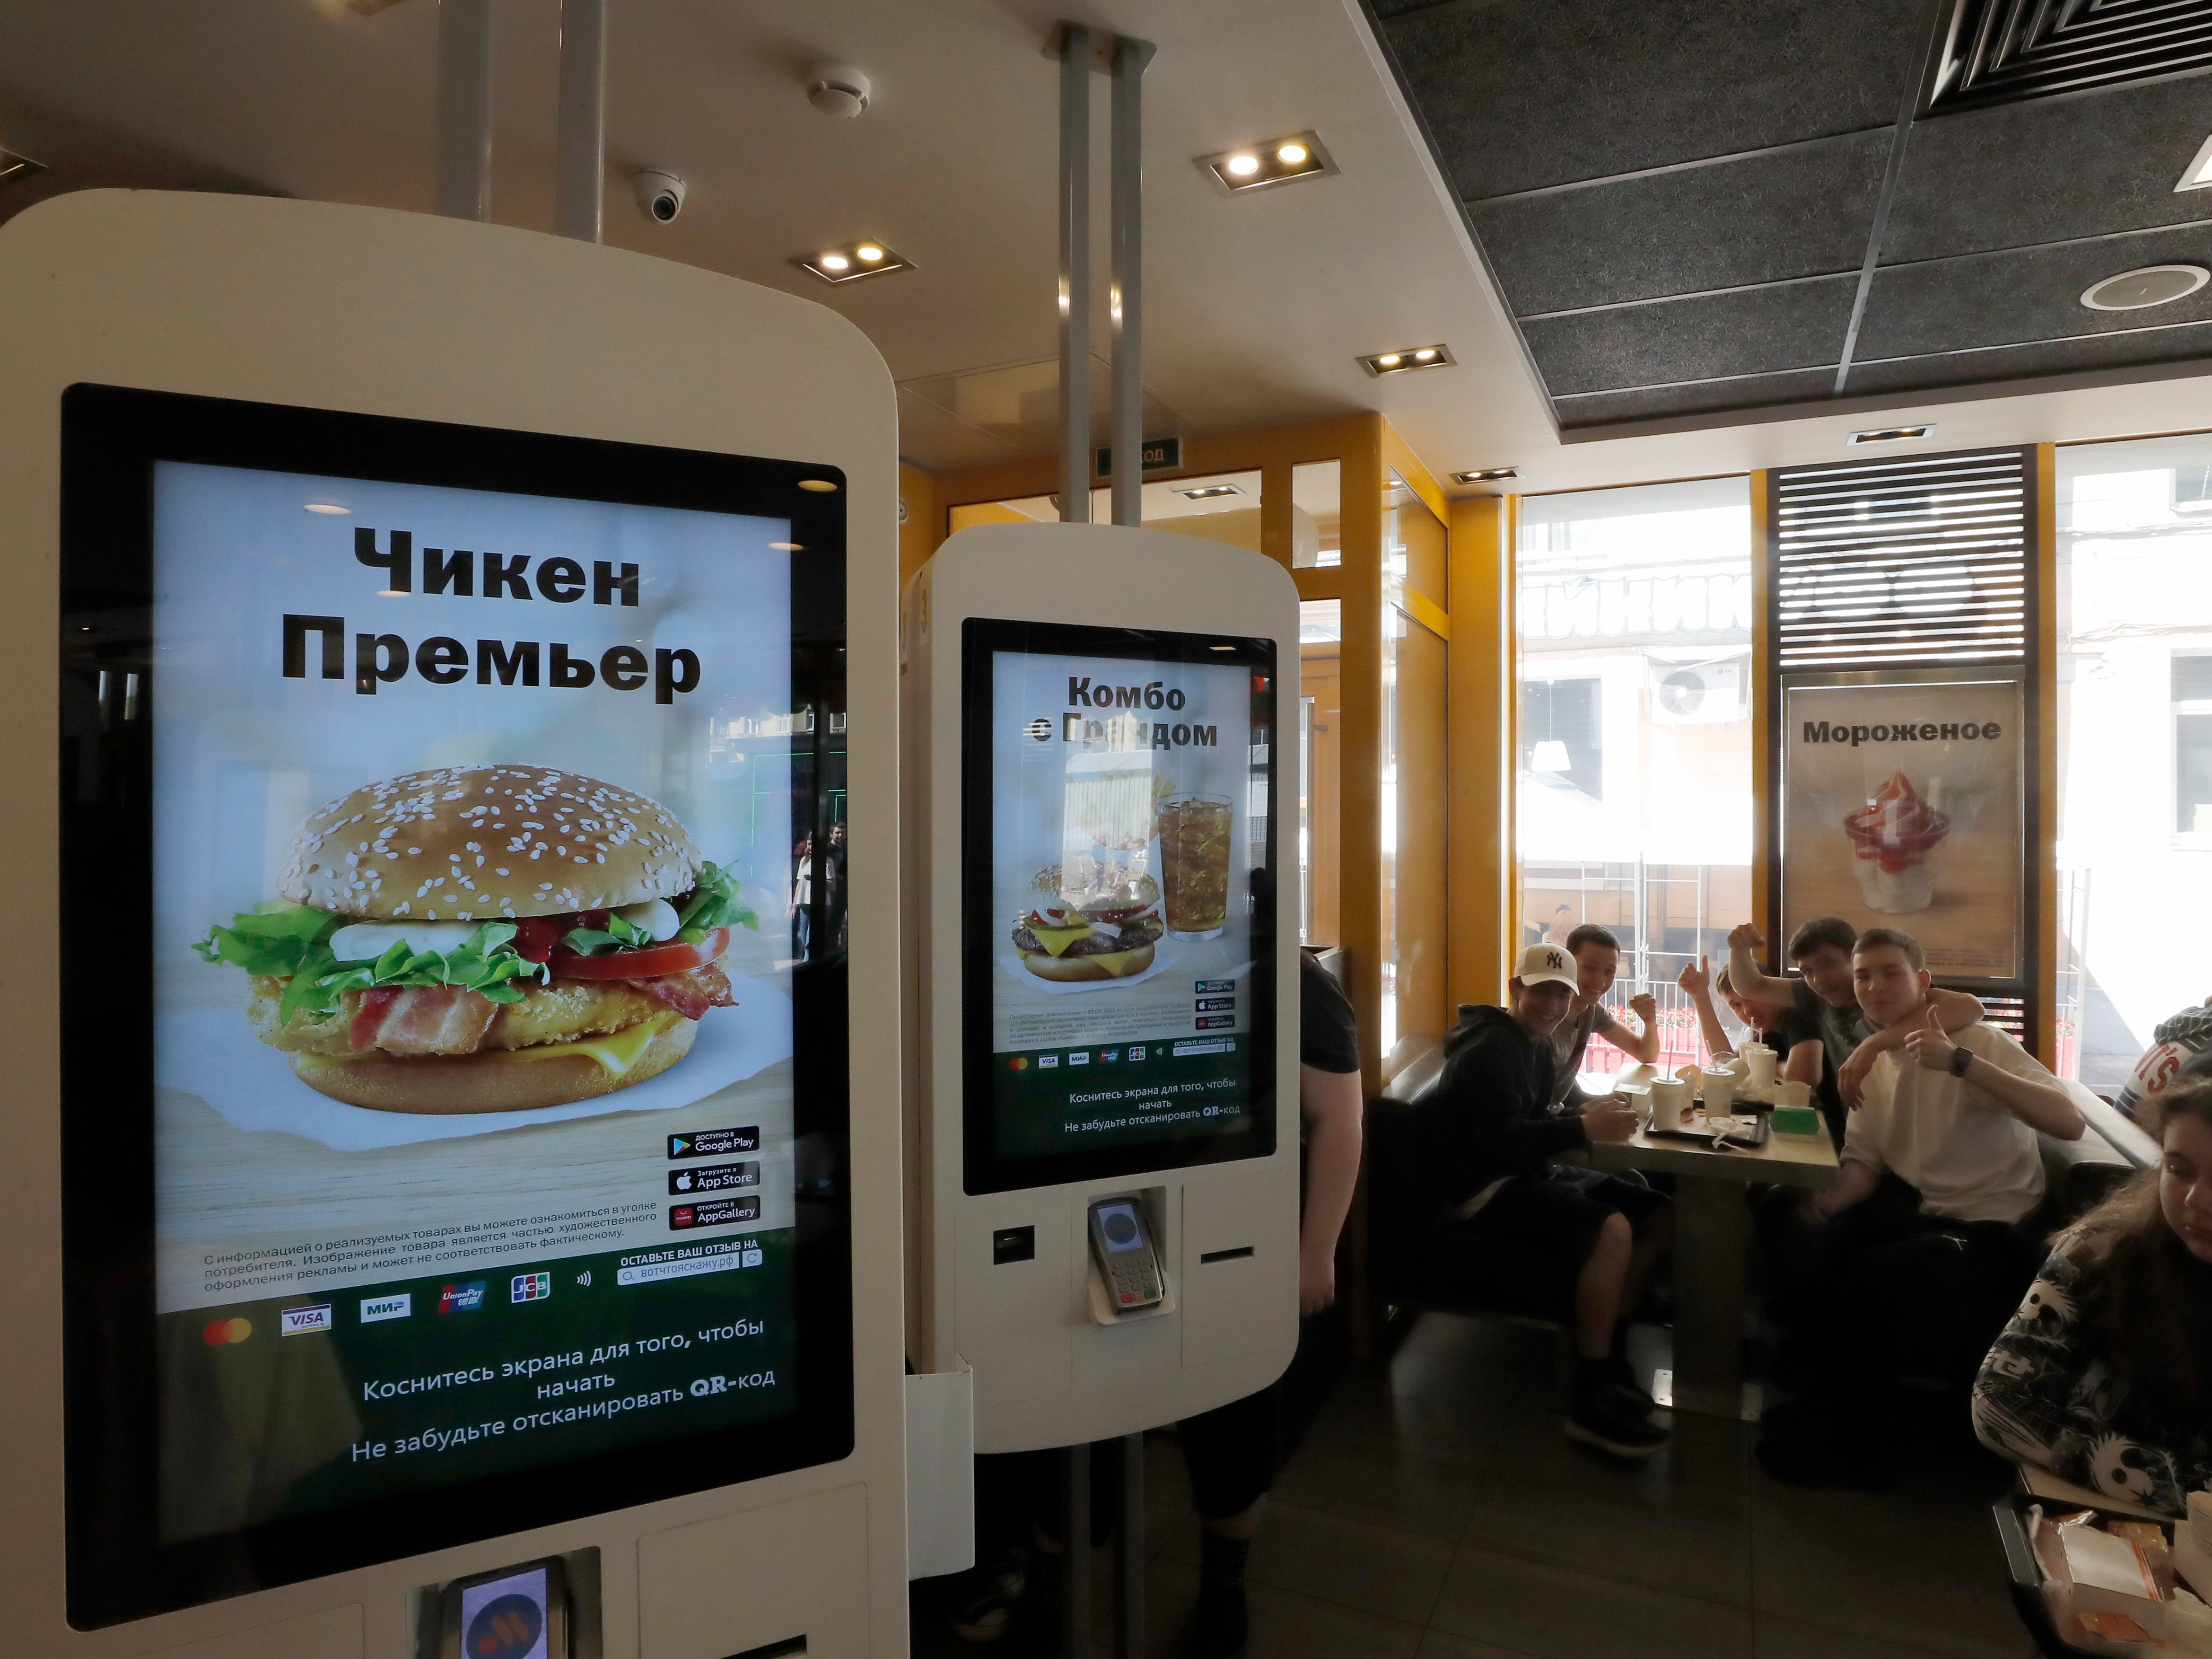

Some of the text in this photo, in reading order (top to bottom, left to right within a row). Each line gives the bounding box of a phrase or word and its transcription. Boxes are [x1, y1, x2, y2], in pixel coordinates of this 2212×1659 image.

[354, 527, 639, 607] Чикен
[282, 614, 700, 704] Премьер
[1069, 676, 1185, 711] Комбо
[1063, 712, 1217, 750] Грандом
[1803, 721, 2002, 746] Мороженое
[1547, 951, 1562, 969] NY
[1070, 1078, 1236, 1104] Коснитесь экрана для того, чтобы
[1139, 1100, 1172, 1111] начать
[1065, 1106, 1241, 1132] Не забудьте отсканировать QR-код
[695, 1132, 729, 1141] ДОСТУПНО
[695, 1138, 754, 1151] Google Play
[697, 1168, 731, 1177] Загрузите
[697, 1174, 752, 1189] App Store
[697, 1202, 729, 1211] ОТКРОЙТЕ
[698, 1207, 755, 1223] AppGallery
[204, 1255, 214, 1265] С
[217, 1244, 311, 1266] информацией
[326, 1231, 410, 1251] реализуемых
[414, 1226, 462, 1239] товарах
[464, 1224, 481, 1233] вы
[483, 1218, 527, 1230] можете
[530, 1208, 610, 1225] ознакомиться
[621, 1202, 656, 1214] уголке
[205, 1213, 656, 1277] потребителя. Изображение товара является частью художественного
[204, 1273, 293, 1292] оформления
[297, 1265, 357, 1281] рекламы
[373, 1257, 413, 1269] может
[418, 1254, 431, 1263] не
[435, 1241, 537, 1261] соответствовать
[540, 1229, 624, 1248] фактическому.
[621, 1239, 758, 1266] ОСТАВЬТЕ ВАШ ОТЗЫВ НА
[641, 1255, 733, 1278] вотчтояскажу.рф
[443, 1289, 483, 1300] UnionPay
[514, 1282, 547, 1294] JCB
[289, 1312, 324, 1325] VISA
[367, 1301, 404, 1315] МИР
[363, 1319, 764, 1401] Коснитесь экрана для того, чтобы
[537, 1373, 615, 1400] начать
[351, 1369, 776, 1463] Не забудьте отсканировать QR-код
